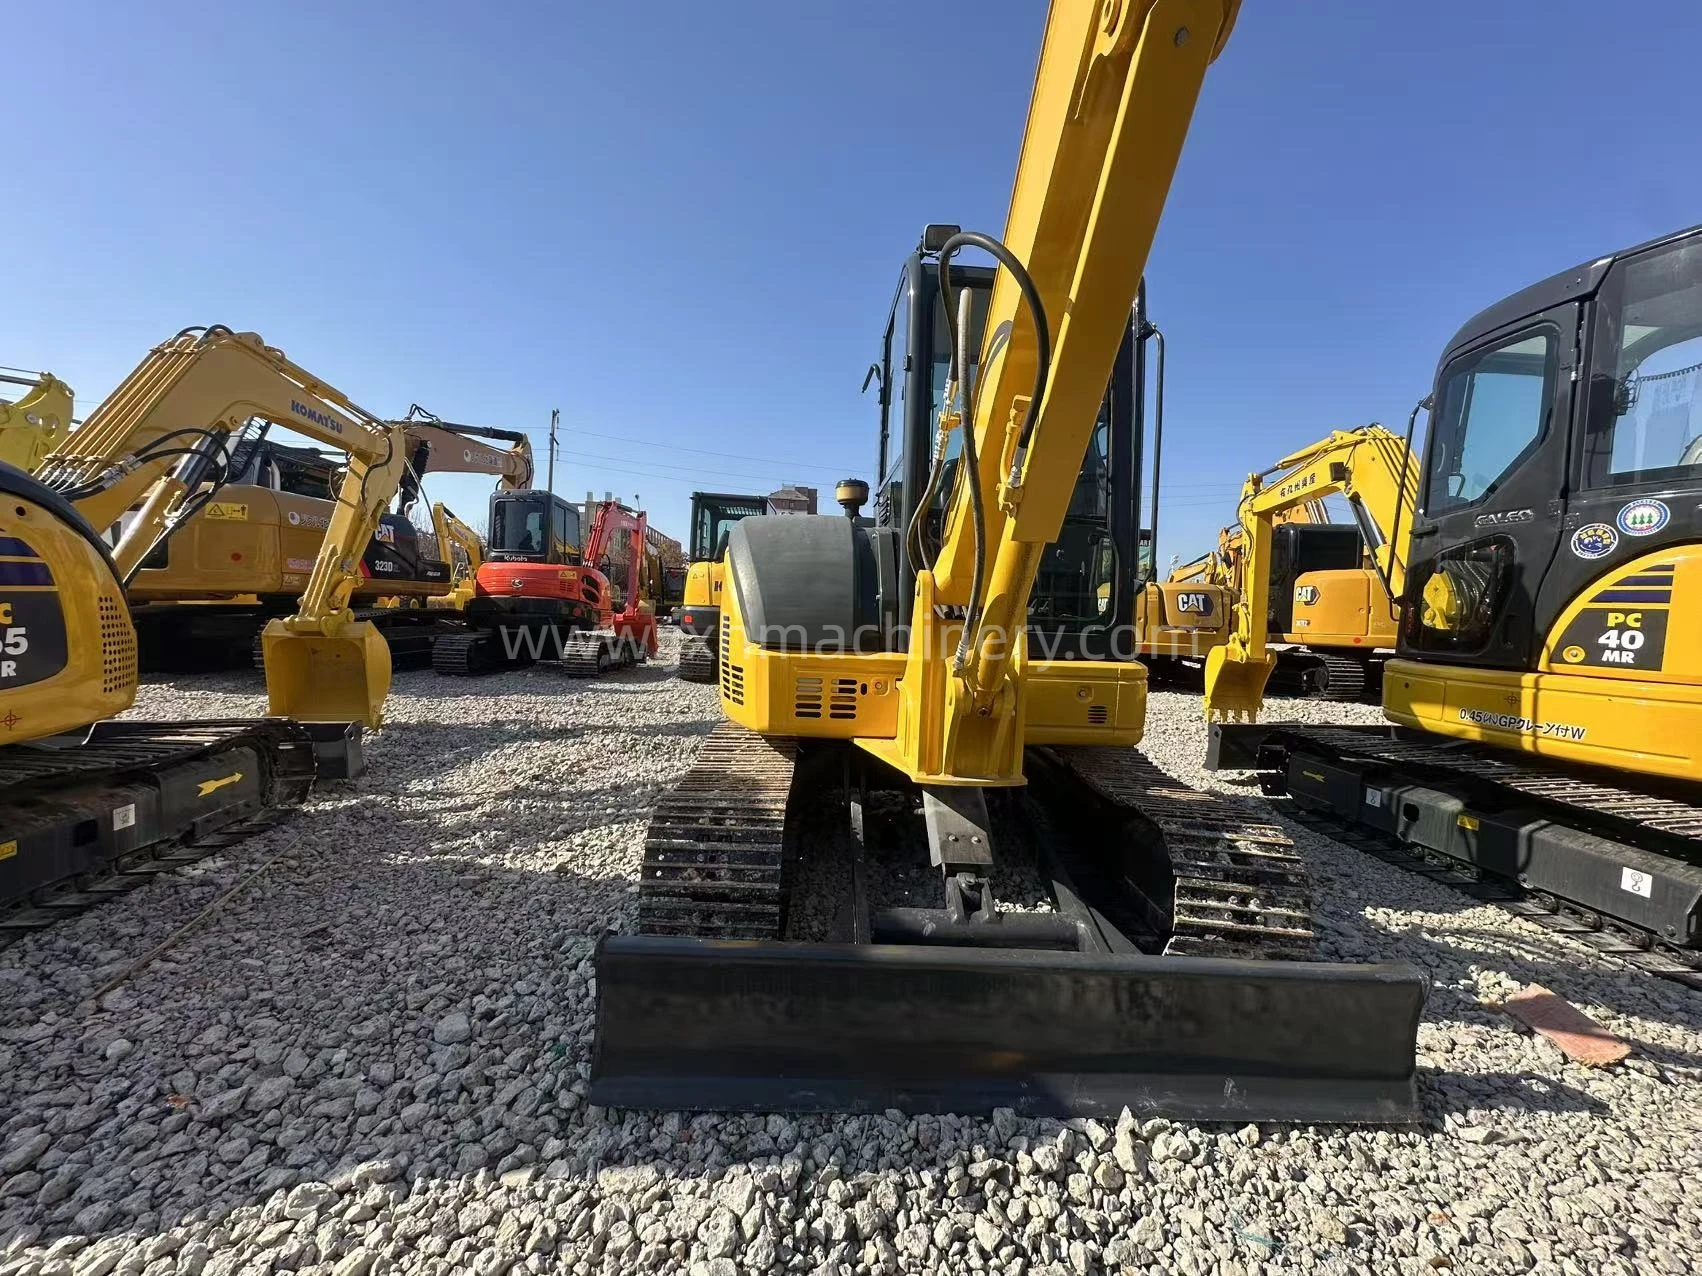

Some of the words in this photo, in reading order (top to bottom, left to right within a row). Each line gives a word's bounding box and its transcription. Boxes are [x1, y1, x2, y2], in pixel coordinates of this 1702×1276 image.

[291, 399, 343, 434] KOMATSU
[375, 523, 395, 543] CAT
[375, 560, 393, 572] 323D
[1177, 593, 1205, 612] CAT
[1295, 586, 1314, 602] CAT
[1607, 612, 1642, 628] PC
[0, 627, 28, 655] 5
[1597, 629, 1645, 650] 40
[1601, 649, 1635, 664] MR
